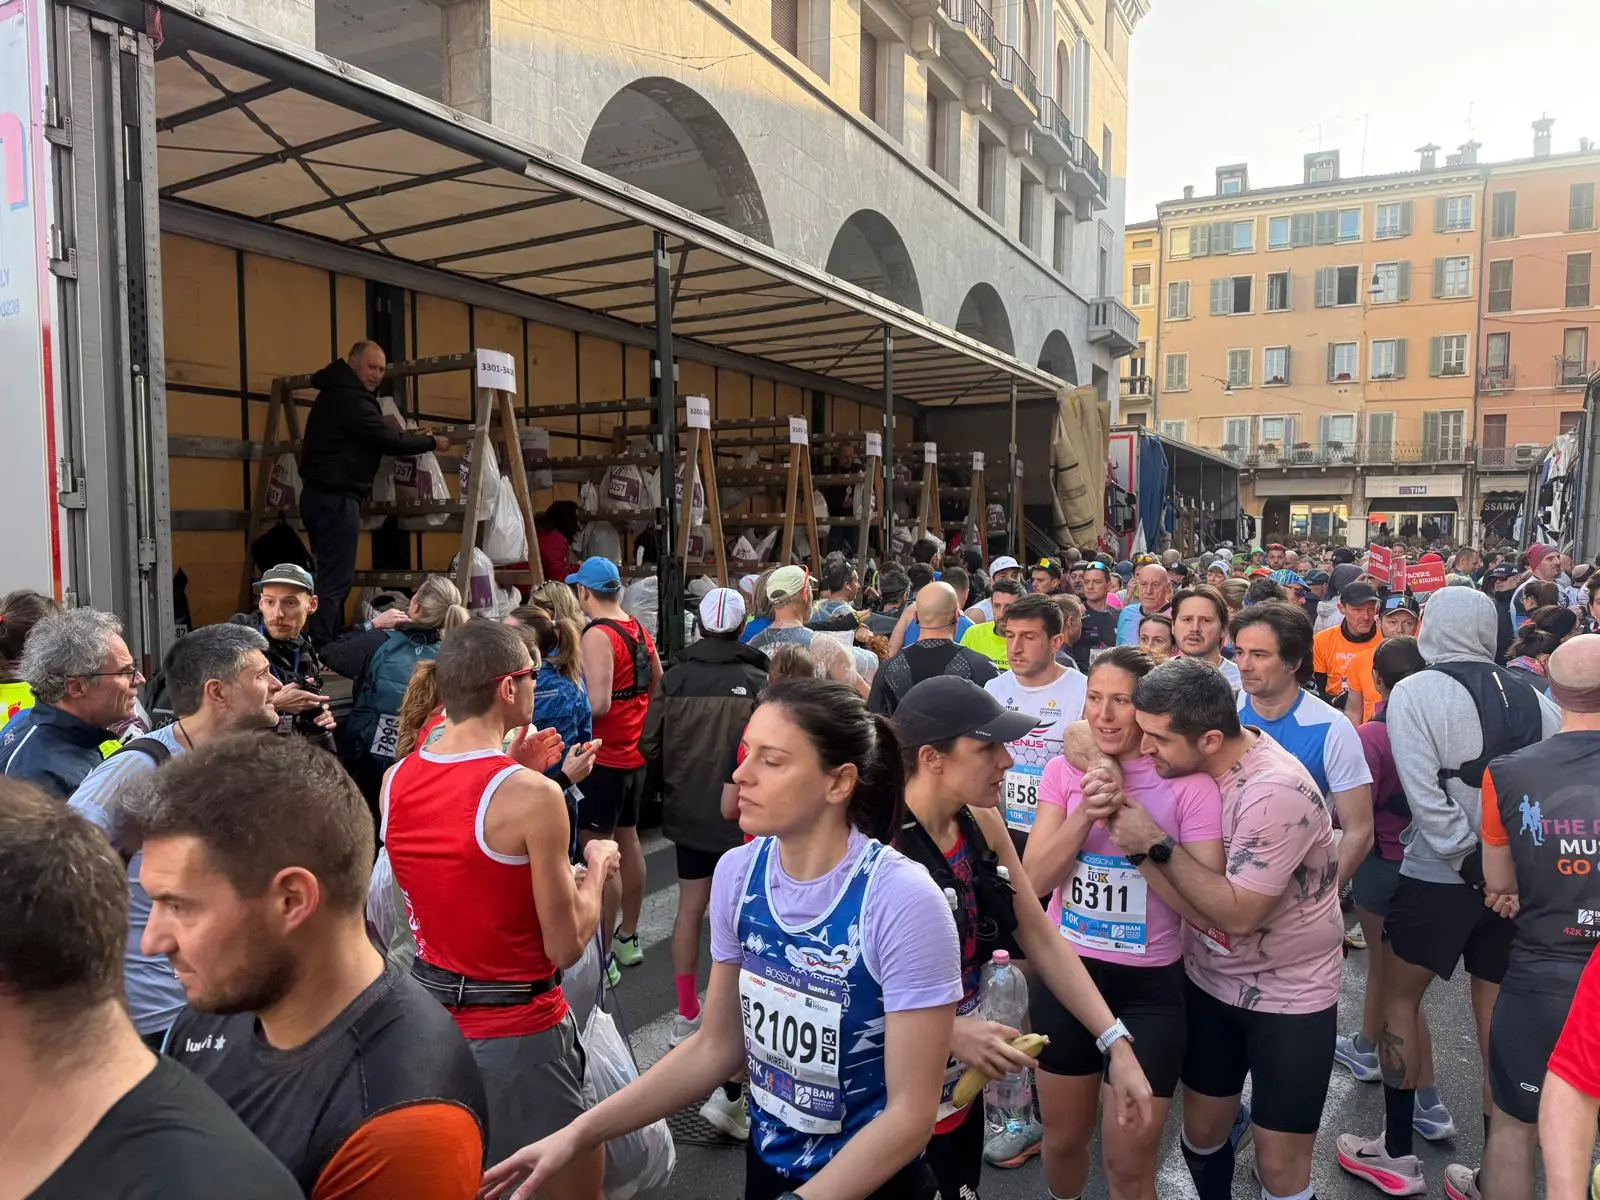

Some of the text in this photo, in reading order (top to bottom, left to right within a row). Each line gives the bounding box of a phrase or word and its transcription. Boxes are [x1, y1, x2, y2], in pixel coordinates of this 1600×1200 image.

[1406, 571, 1430, 579] ACERS
[1009, 739, 1044, 748] ENUS
[1017, 784, 1040, 805] 58
[1010, 811, 1024, 819] 10K
[1541, 819, 1585, 835] THE
[1560, 839, 1600, 855] MU
[1557, 858, 1591, 875] GO
[1088, 871, 1109, 884] 10K
[1072, 876, 1128, 913] 6311
[1065, 911, 1079, 927] 10K
[766, 966, 801, 988] BOSSONI
[753, 1001, 817, 1064] 2109
[747, 1055, 763, 1078] 21K
[812, 1087, 835, 1101] BAM
